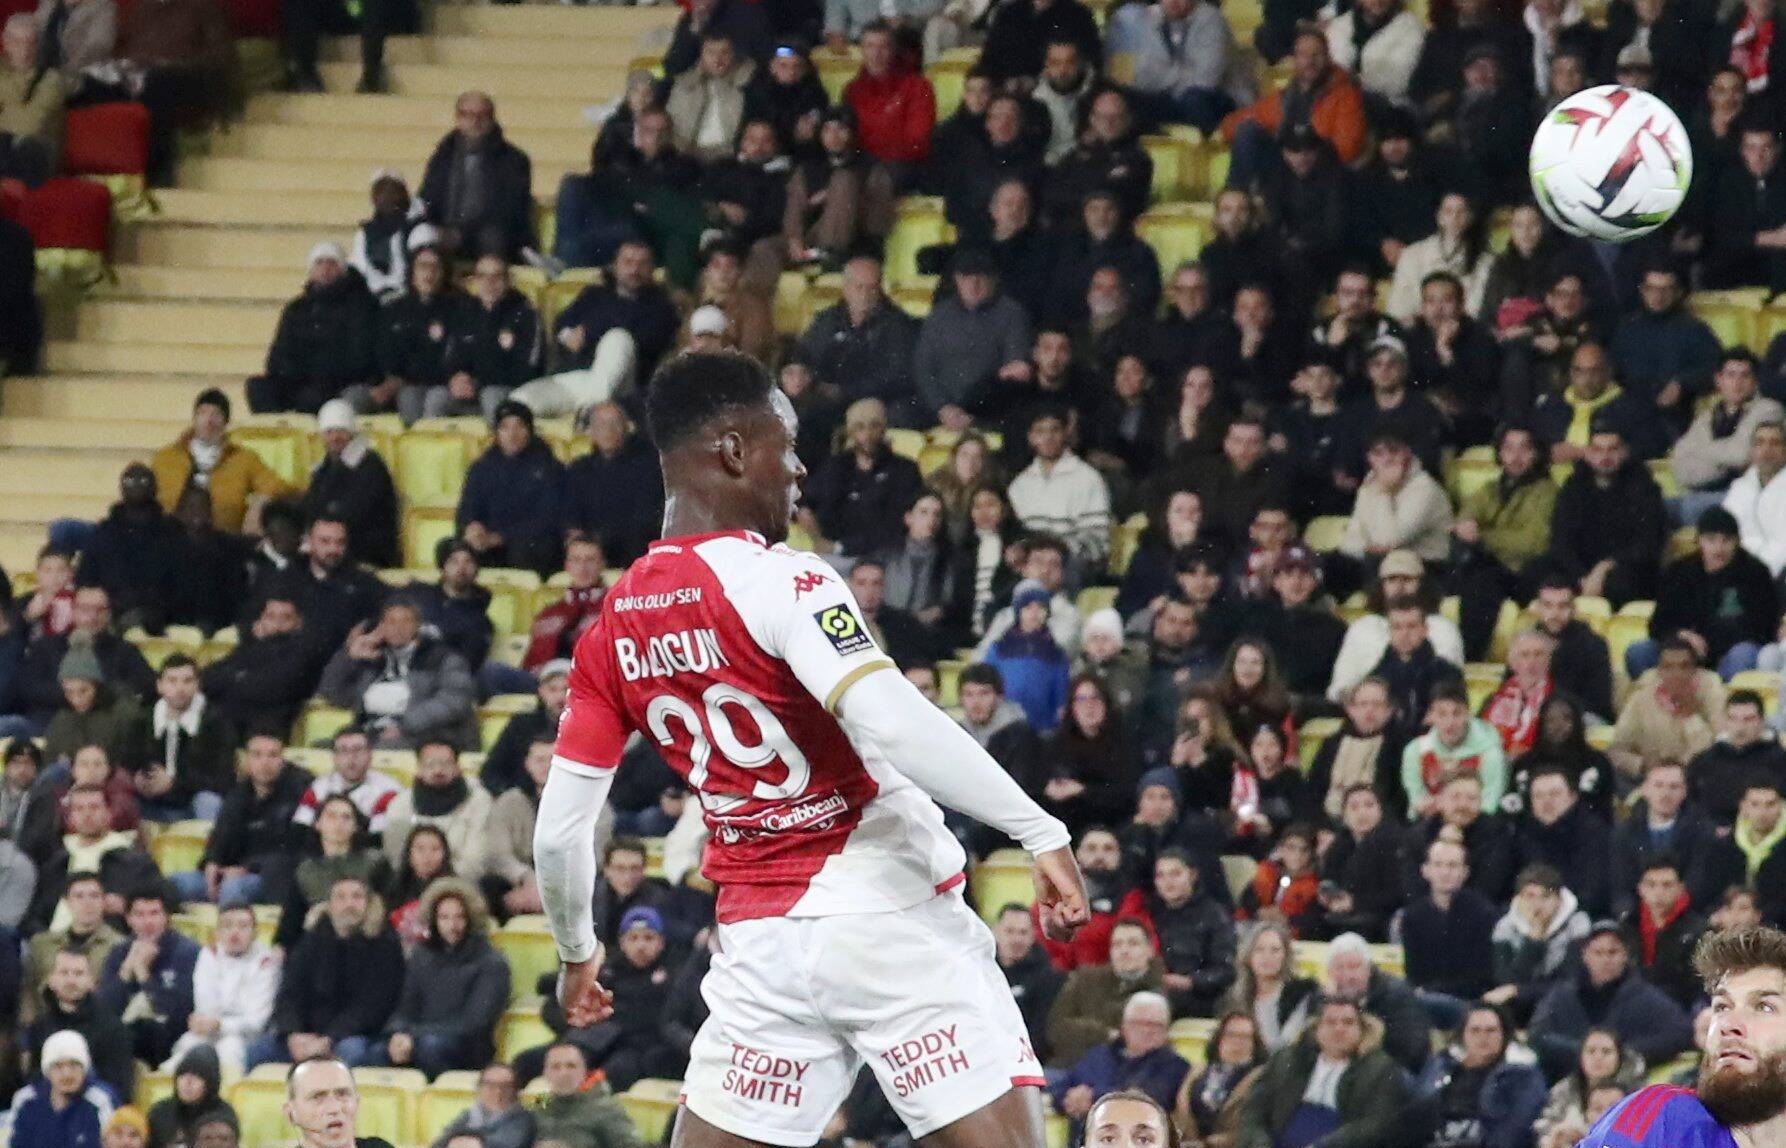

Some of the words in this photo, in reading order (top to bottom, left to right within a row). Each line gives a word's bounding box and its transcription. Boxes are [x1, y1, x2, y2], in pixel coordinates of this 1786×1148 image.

[646, 682, 811, 815] 29
[767, 794, 843, 830] Caribbean
[731, 1043, 810, 1082] TEDDY
[880, 1024, 959, 1073] TEDDY
[722, 1069, 803, 1108] SMITH
[893, 1050, 970, 1098] SMITH
